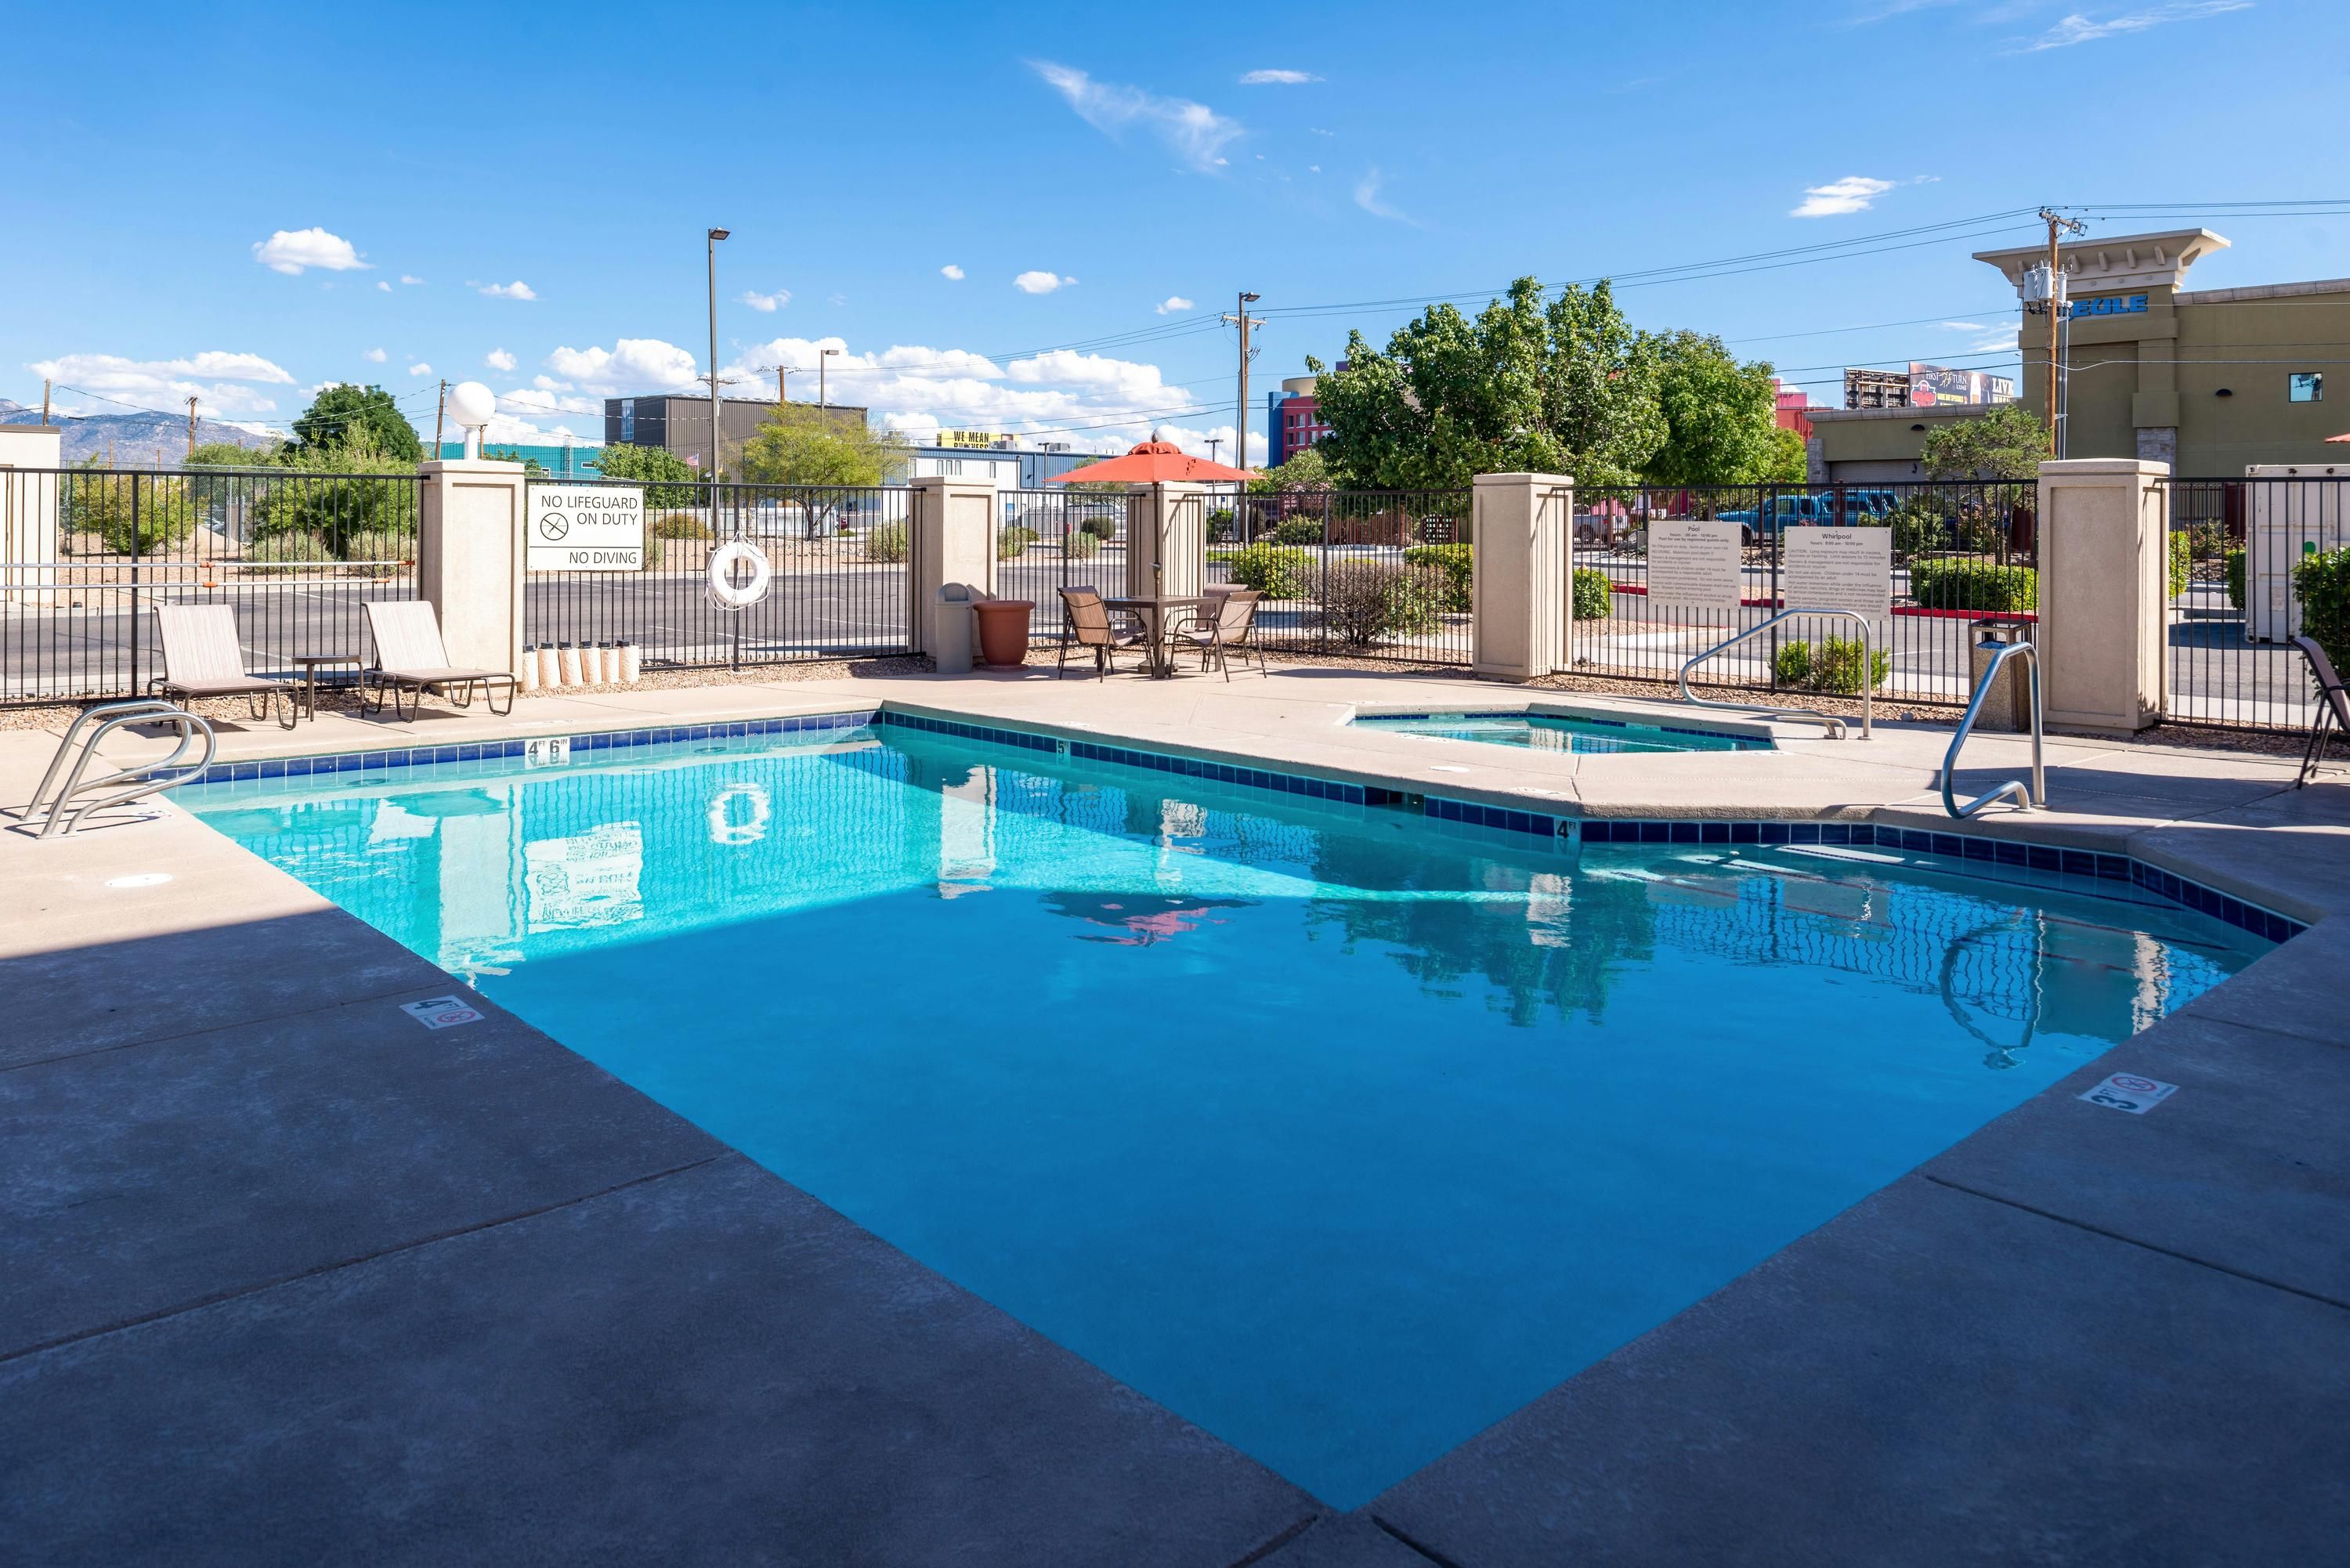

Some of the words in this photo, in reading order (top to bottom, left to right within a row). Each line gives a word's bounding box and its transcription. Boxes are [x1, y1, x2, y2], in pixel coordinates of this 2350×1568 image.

[1952, 374, 1967, 385] TURN
[954, 431, 965, 442] WE
[969, 432, 989, 444] MEAN
[542, 495, 562, 508] NO
[568, 497, 638, 509] LIFEGUARD
[577, 513, 597, 525] ON
[602, 513, 638, 526] DUTY
[569, 552, 589, 564] NO
[594, 552, 637, 564] DIVING
[528, 741, 539, 754] 4
[549, 739, 560, 753] 6
[1058, 739, 1065, 753] 5
[1557, 820, 1569, 838] 4
[2091, 1095, 2138, 1110] 3
